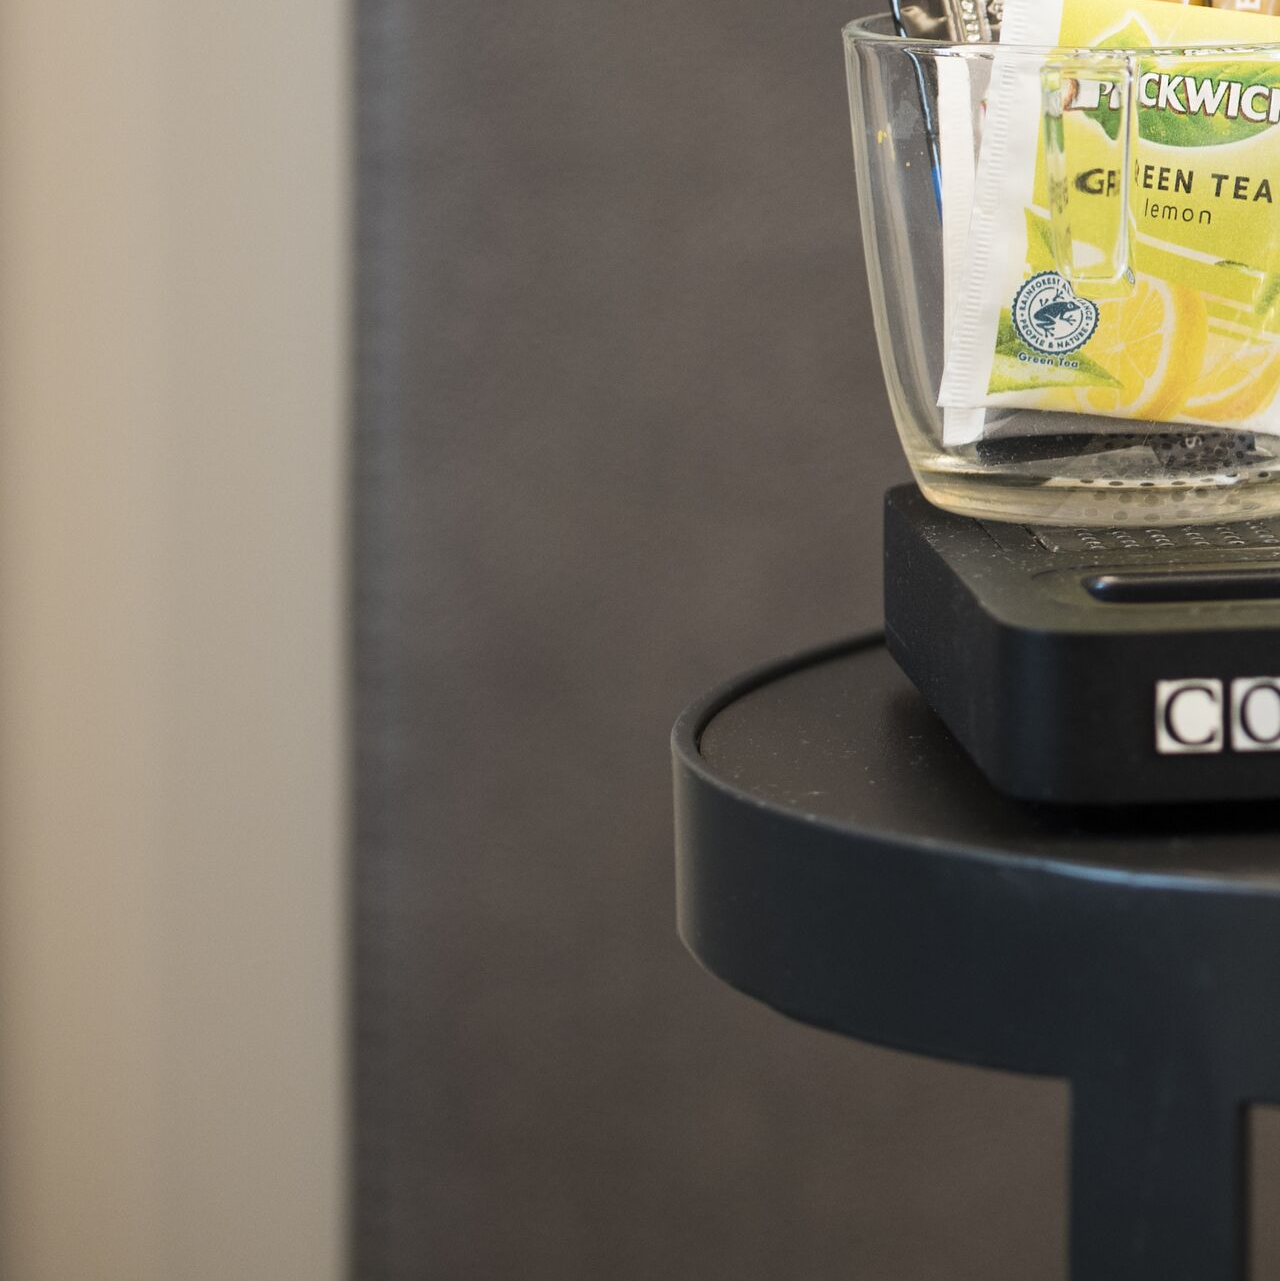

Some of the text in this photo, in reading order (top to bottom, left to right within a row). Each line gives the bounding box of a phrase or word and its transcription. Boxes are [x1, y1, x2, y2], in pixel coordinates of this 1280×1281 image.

[1211, 173, 1274, 204] TEA
[1144, 198, 1213, 225] lemon
[1019, 318, 1046, 348] PEOPLE
[1056, 327, 1089, 349] NATURE
[1018, 351, 1079, 369] Green Tea
